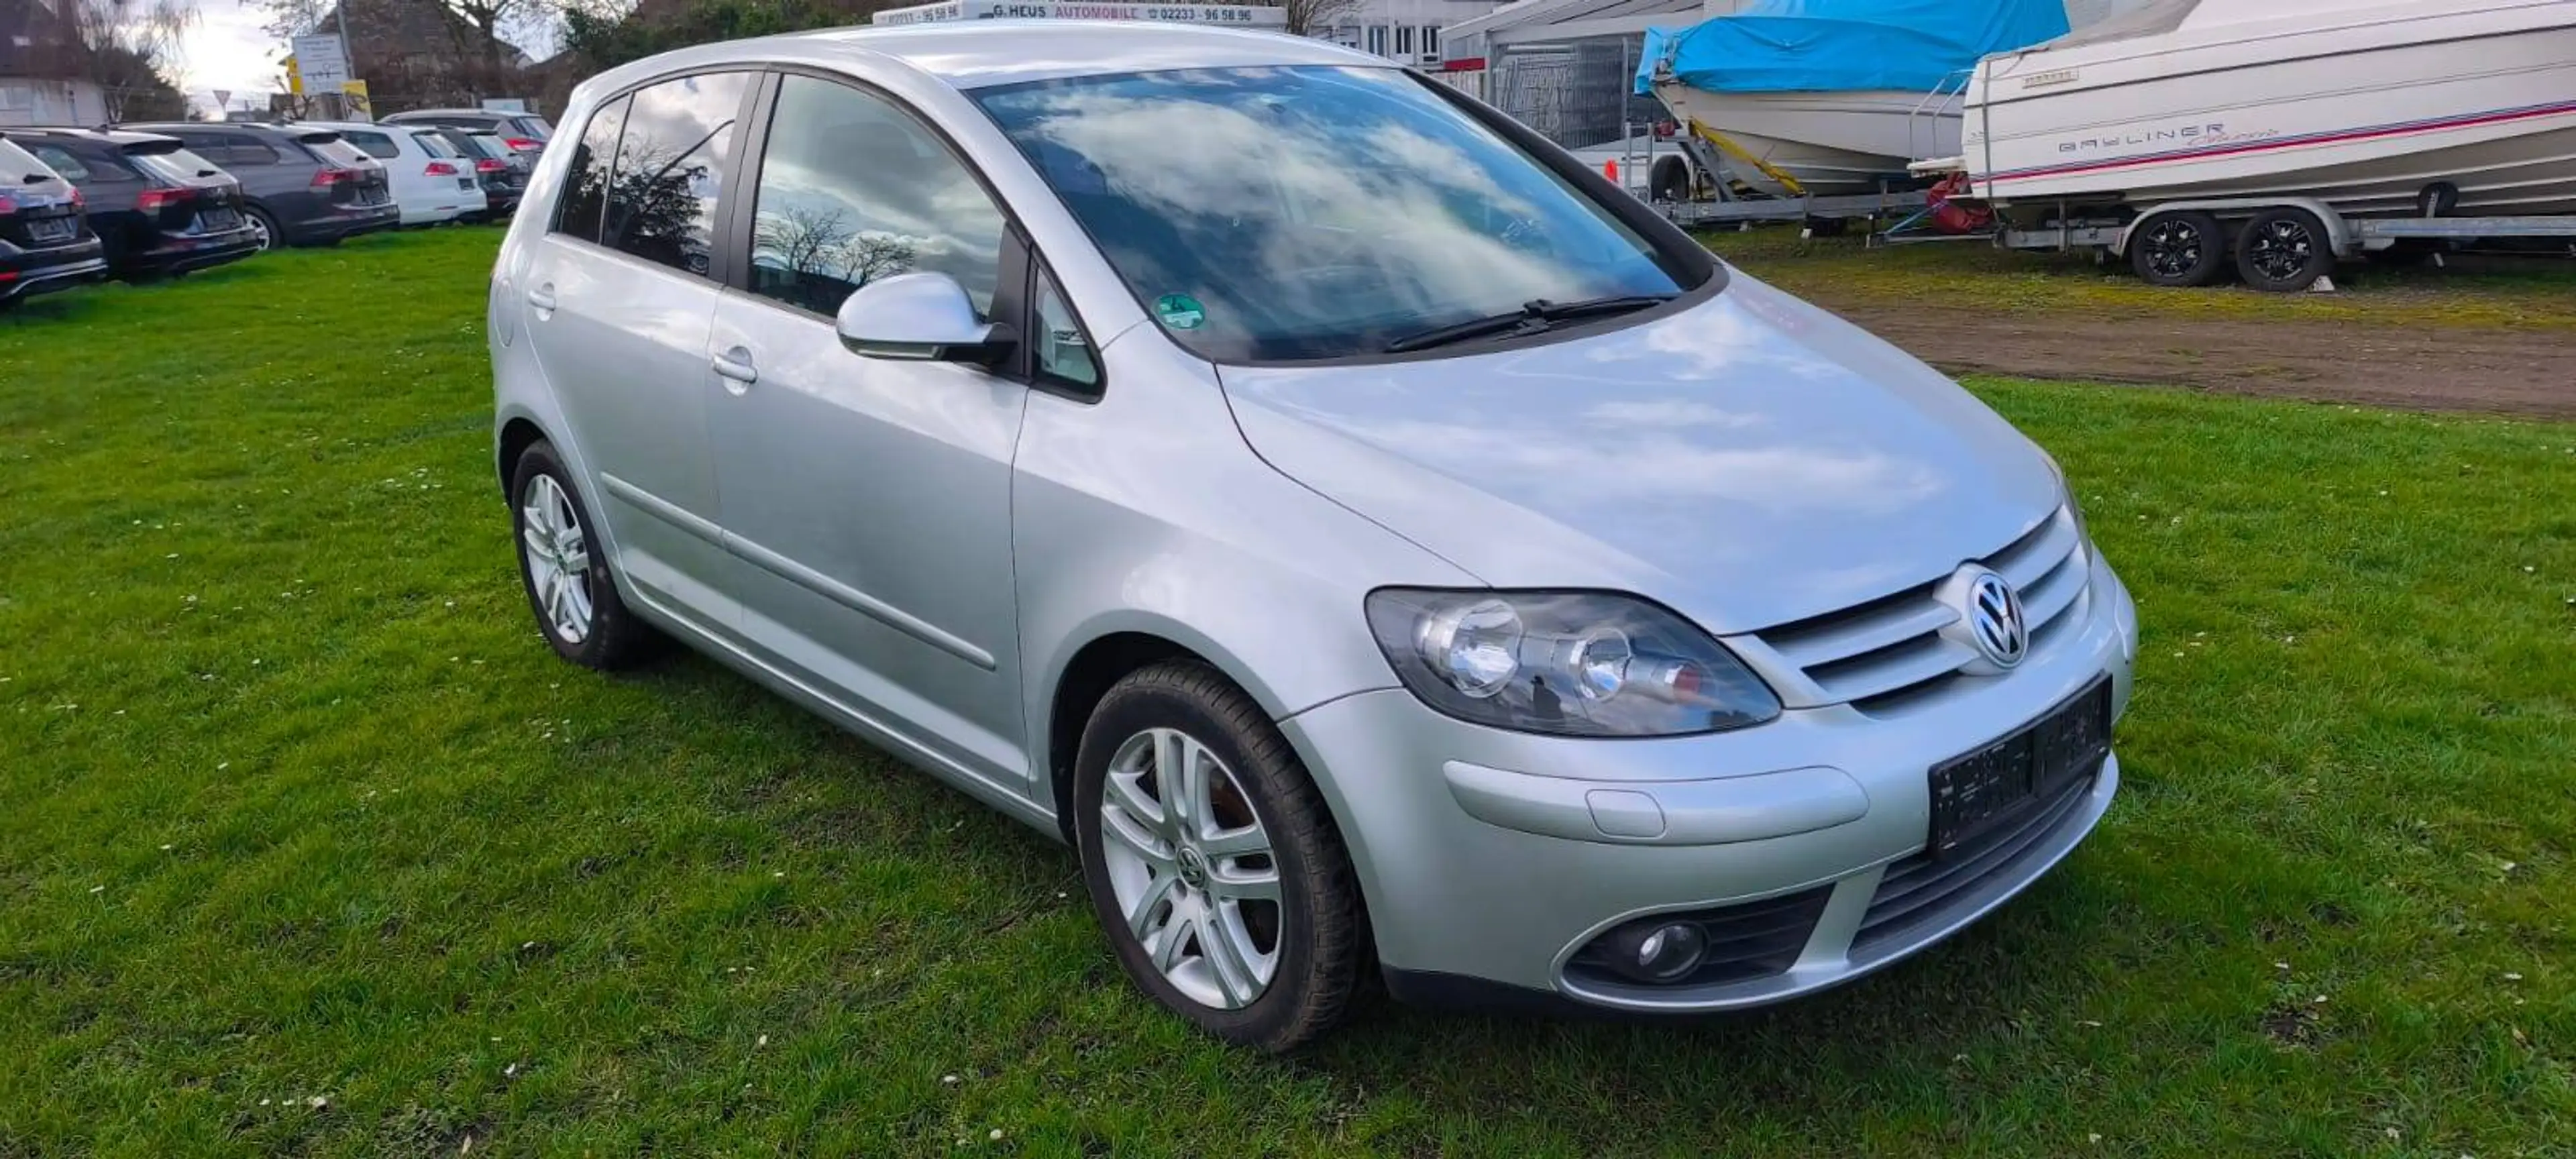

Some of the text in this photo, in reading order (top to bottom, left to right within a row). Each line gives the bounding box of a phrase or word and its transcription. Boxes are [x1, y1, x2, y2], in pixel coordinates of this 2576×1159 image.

[1055, 6, 1139, 19] AUTOMOBILE
[1160, 8, 1195, 20] 02233
[1204, 8, 1219, 20] 96
[1222, 9, 1236, 21] 58
[1238, 9, 1252, 21] 96
[2059, 123, 2226, 152] BAYLINER
